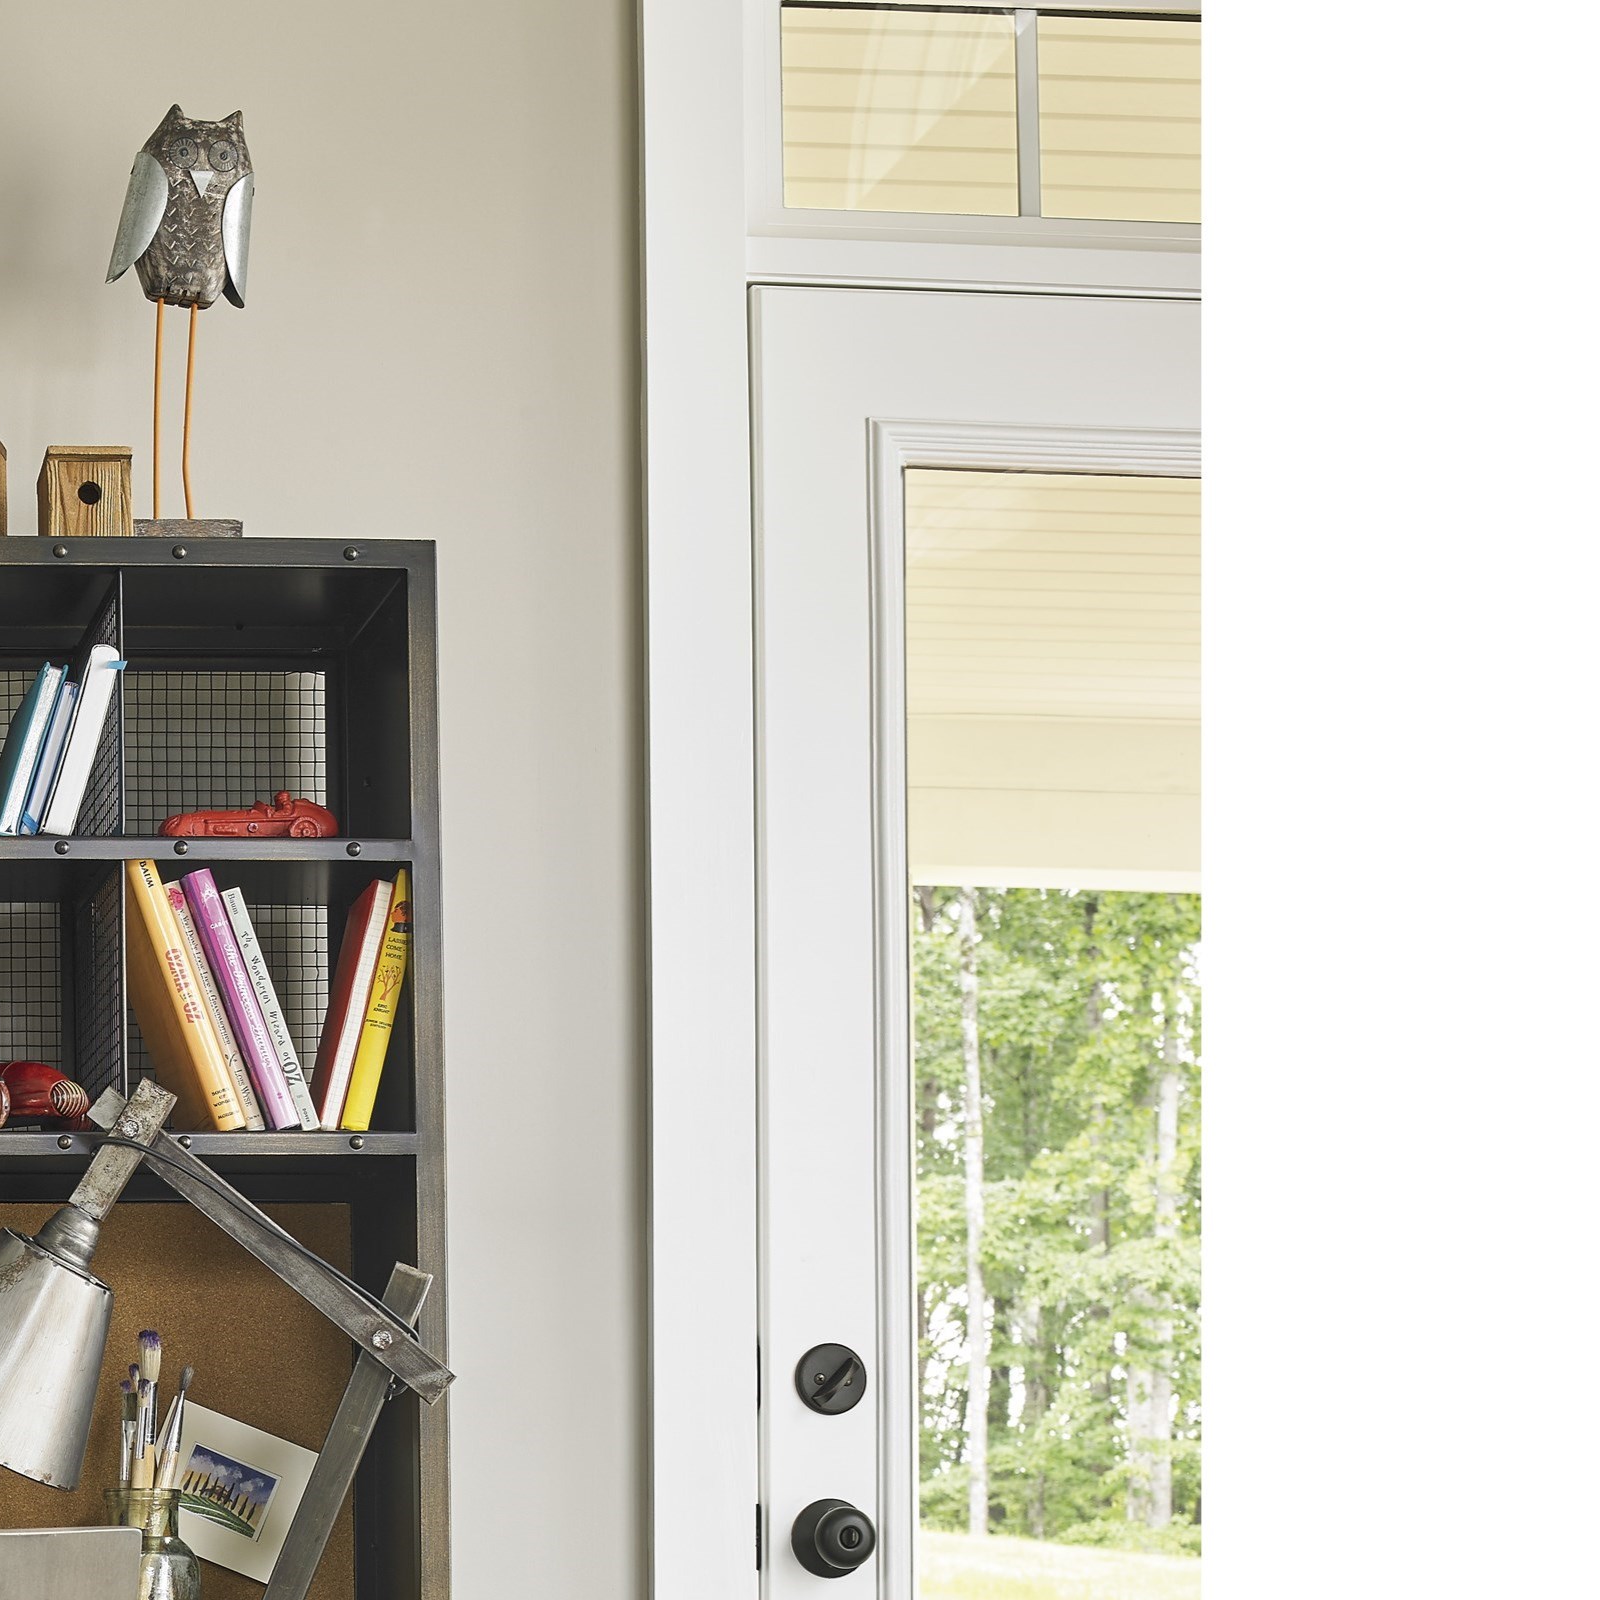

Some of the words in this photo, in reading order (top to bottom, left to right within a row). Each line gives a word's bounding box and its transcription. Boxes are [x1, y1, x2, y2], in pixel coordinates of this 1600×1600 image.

[227, 893, 239, 916] Baum
[241, 930, 252, 949] The
[251, 955, 272, 1005] Wonderful
[269, 1010, 286, 1047] Wizard
